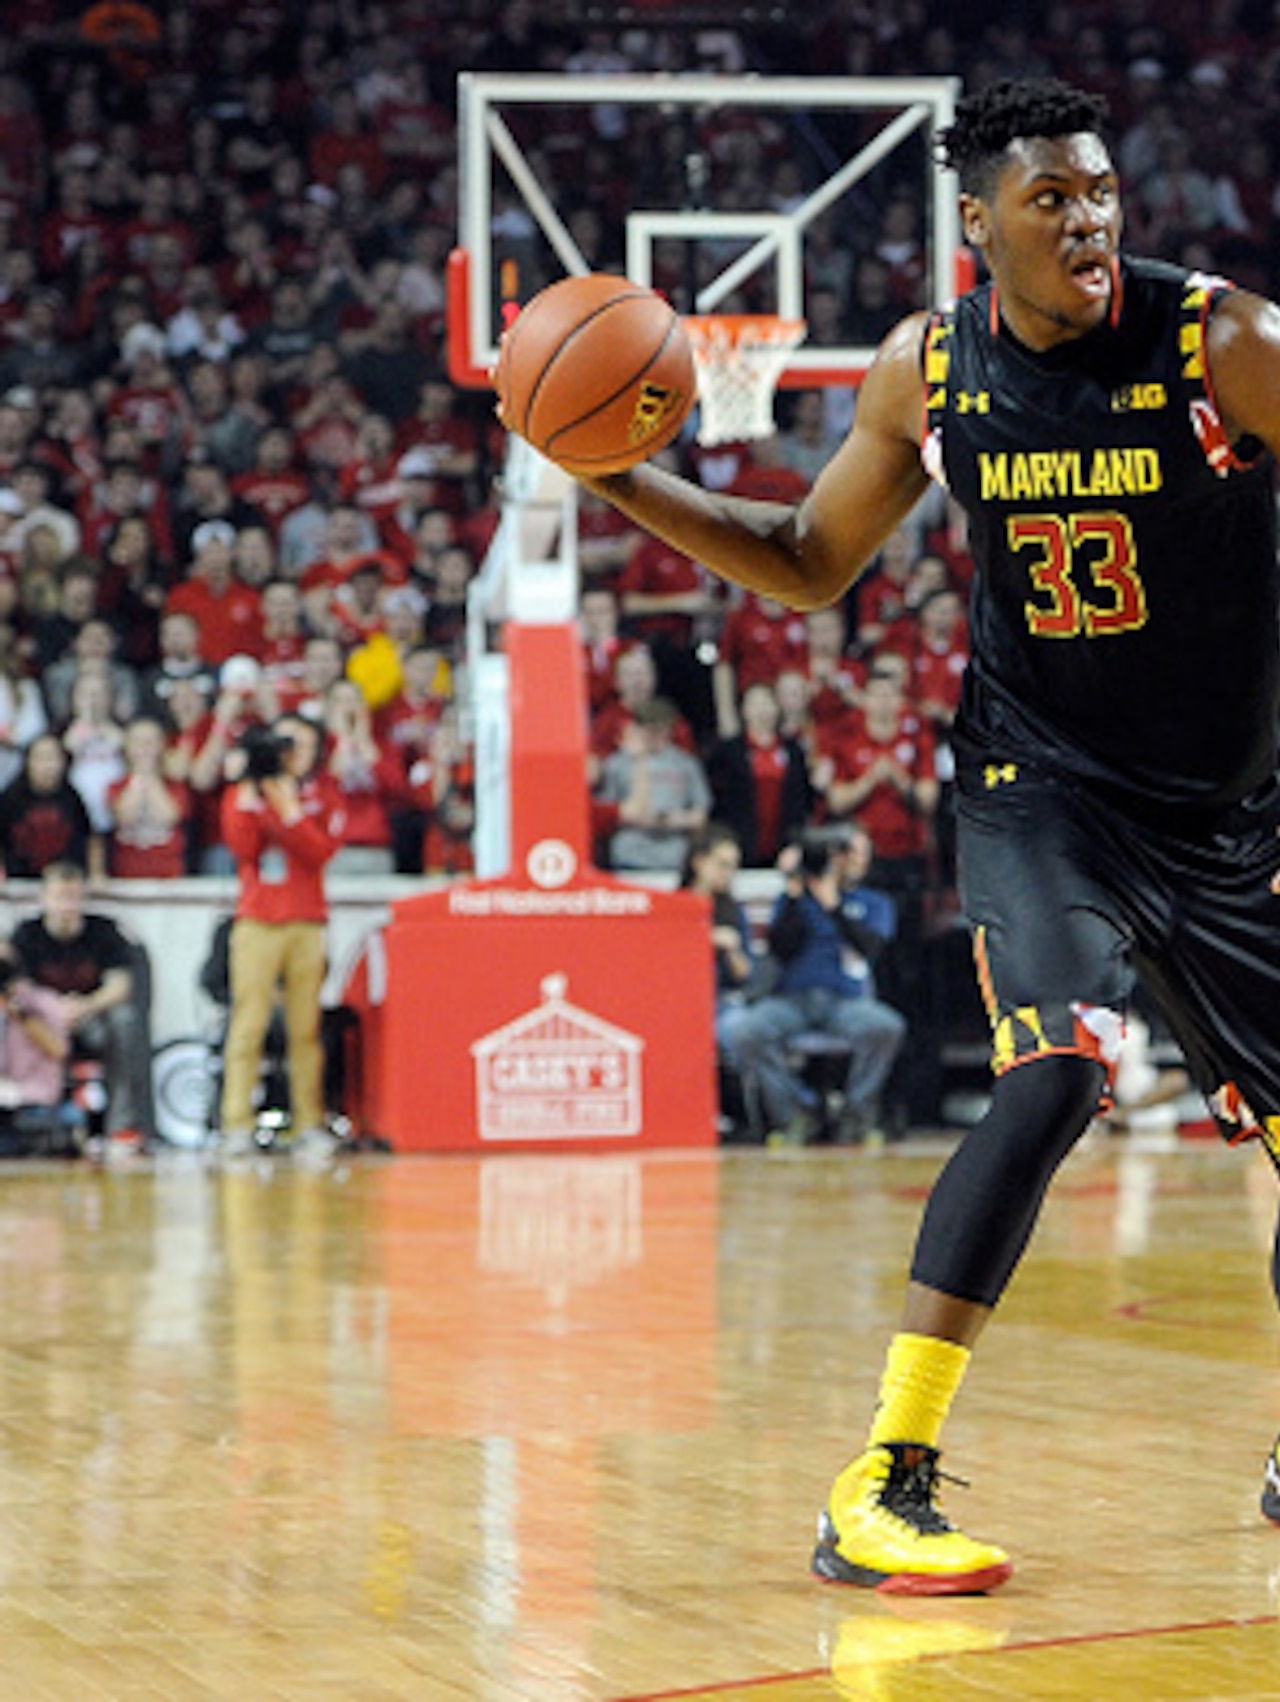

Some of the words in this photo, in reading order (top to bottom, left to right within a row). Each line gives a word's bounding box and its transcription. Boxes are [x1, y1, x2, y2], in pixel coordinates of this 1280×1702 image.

[979, 448, 1162, 500] MARYLAND
[1007, 511, 1147, 639] 33
[495, 890, 589, 915] National
[594, 890, 649, 915] Bank
